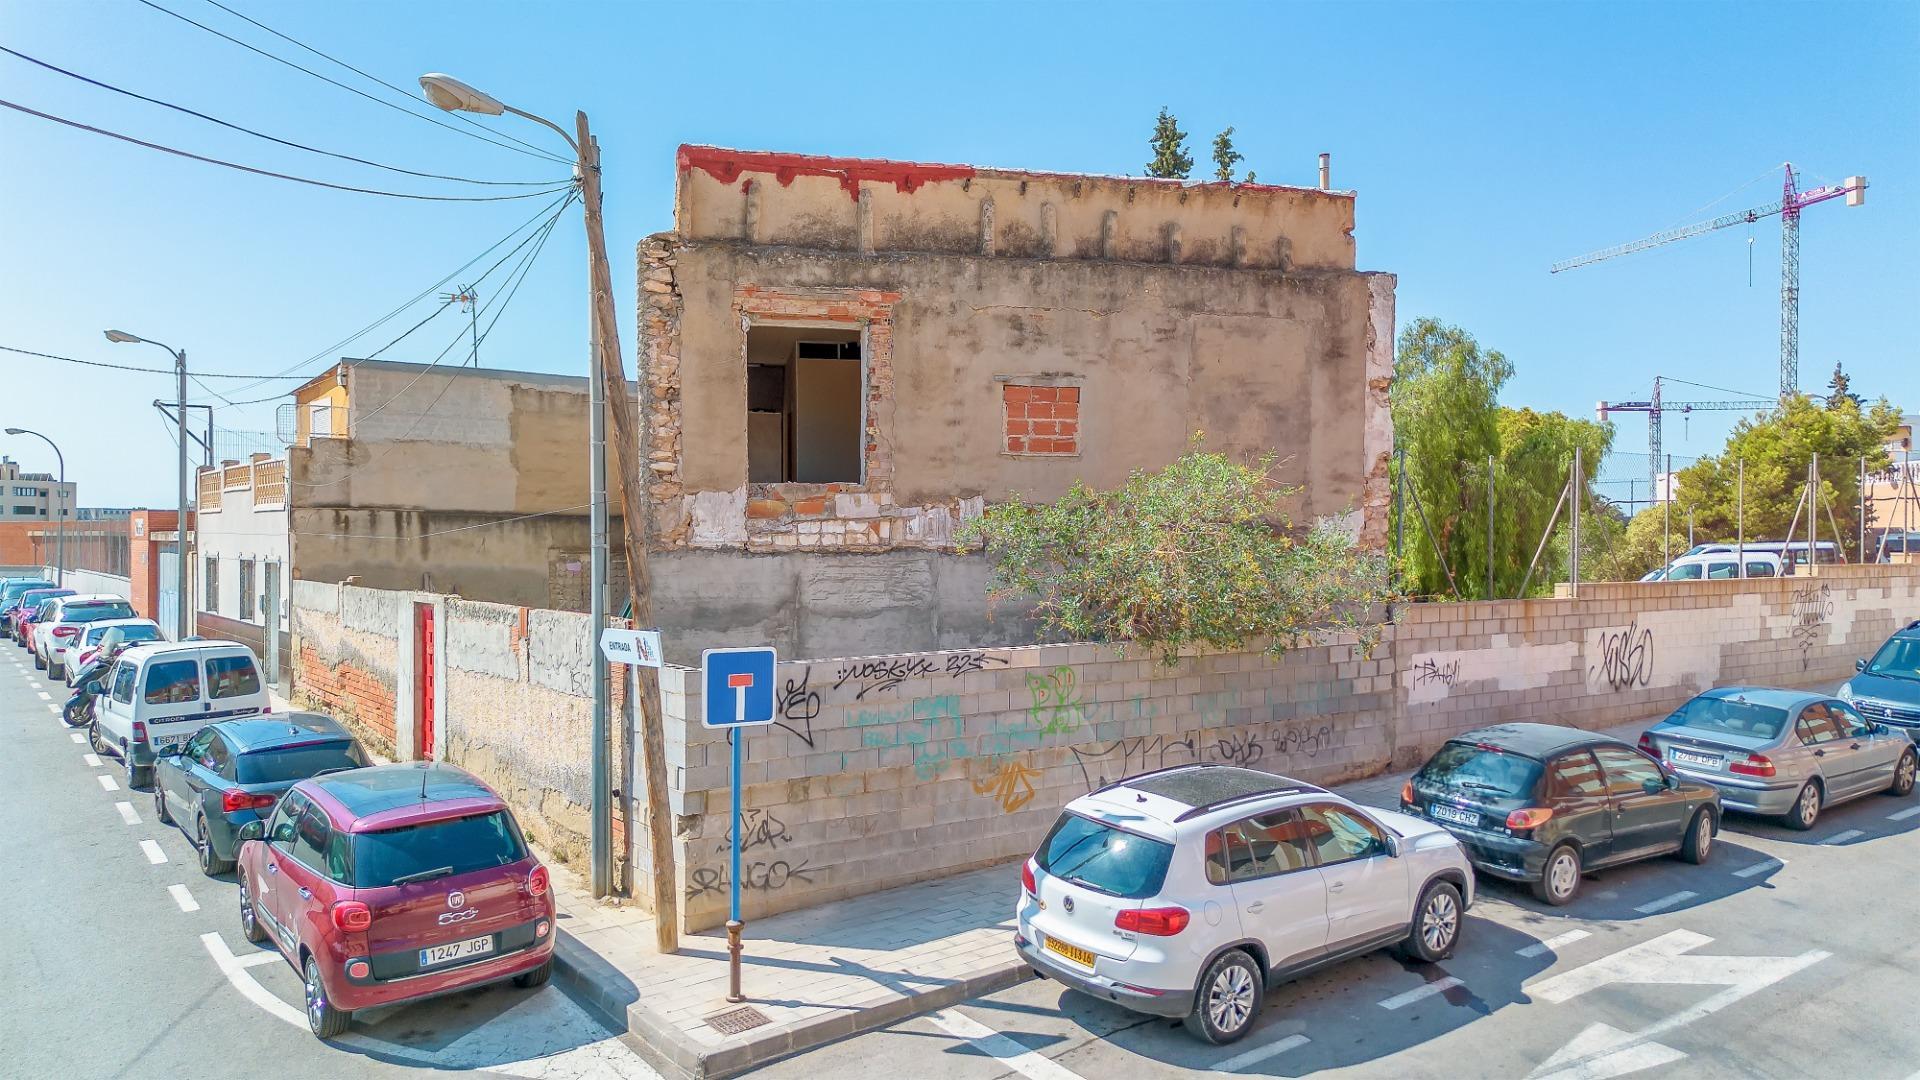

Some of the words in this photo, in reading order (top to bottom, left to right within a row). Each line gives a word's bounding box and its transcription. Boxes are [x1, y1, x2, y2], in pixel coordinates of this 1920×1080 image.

[608, 640, 632, 653] ENTRADA
[1435, 806, 1457, 819] 7019
[1459, 811, 1477, 824] CHZ
[430, 944, 461, 961] 1247
[466, 938, 489, 953] JGP
